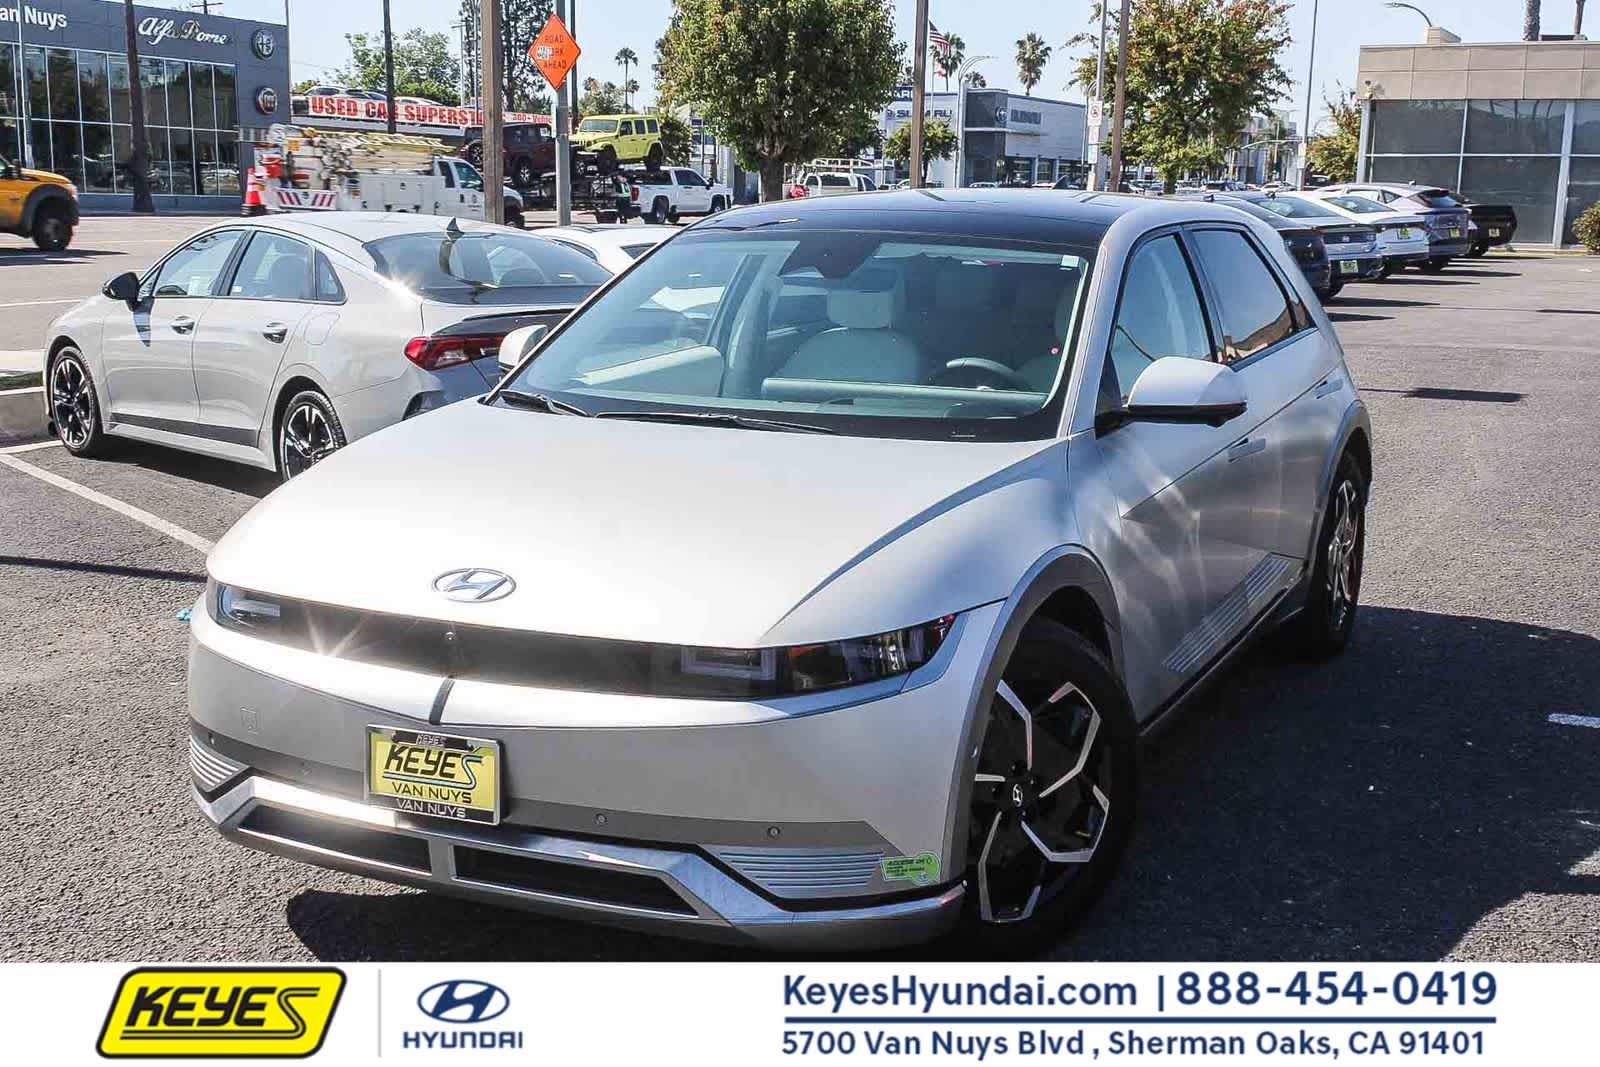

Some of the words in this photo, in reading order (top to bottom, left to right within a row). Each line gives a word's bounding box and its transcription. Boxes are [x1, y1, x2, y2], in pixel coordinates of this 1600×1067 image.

[0, 7, 20, 22] an
[24, 5, 68, 31] Nuys
[138, 17, 180, 46] Alfa
[181, 20, 230, 45] Rome
[311, 97, 359, 117] USED
[895, 109, 952, 118] SUARU
[383, 744, 483, 790] KEYES
[392, 781, 423, 797] VAN
[428, 786, 472, 804] NUYS
[396, 799, 424, 812] VAN
[427, 803, 466, 818] NUYS
